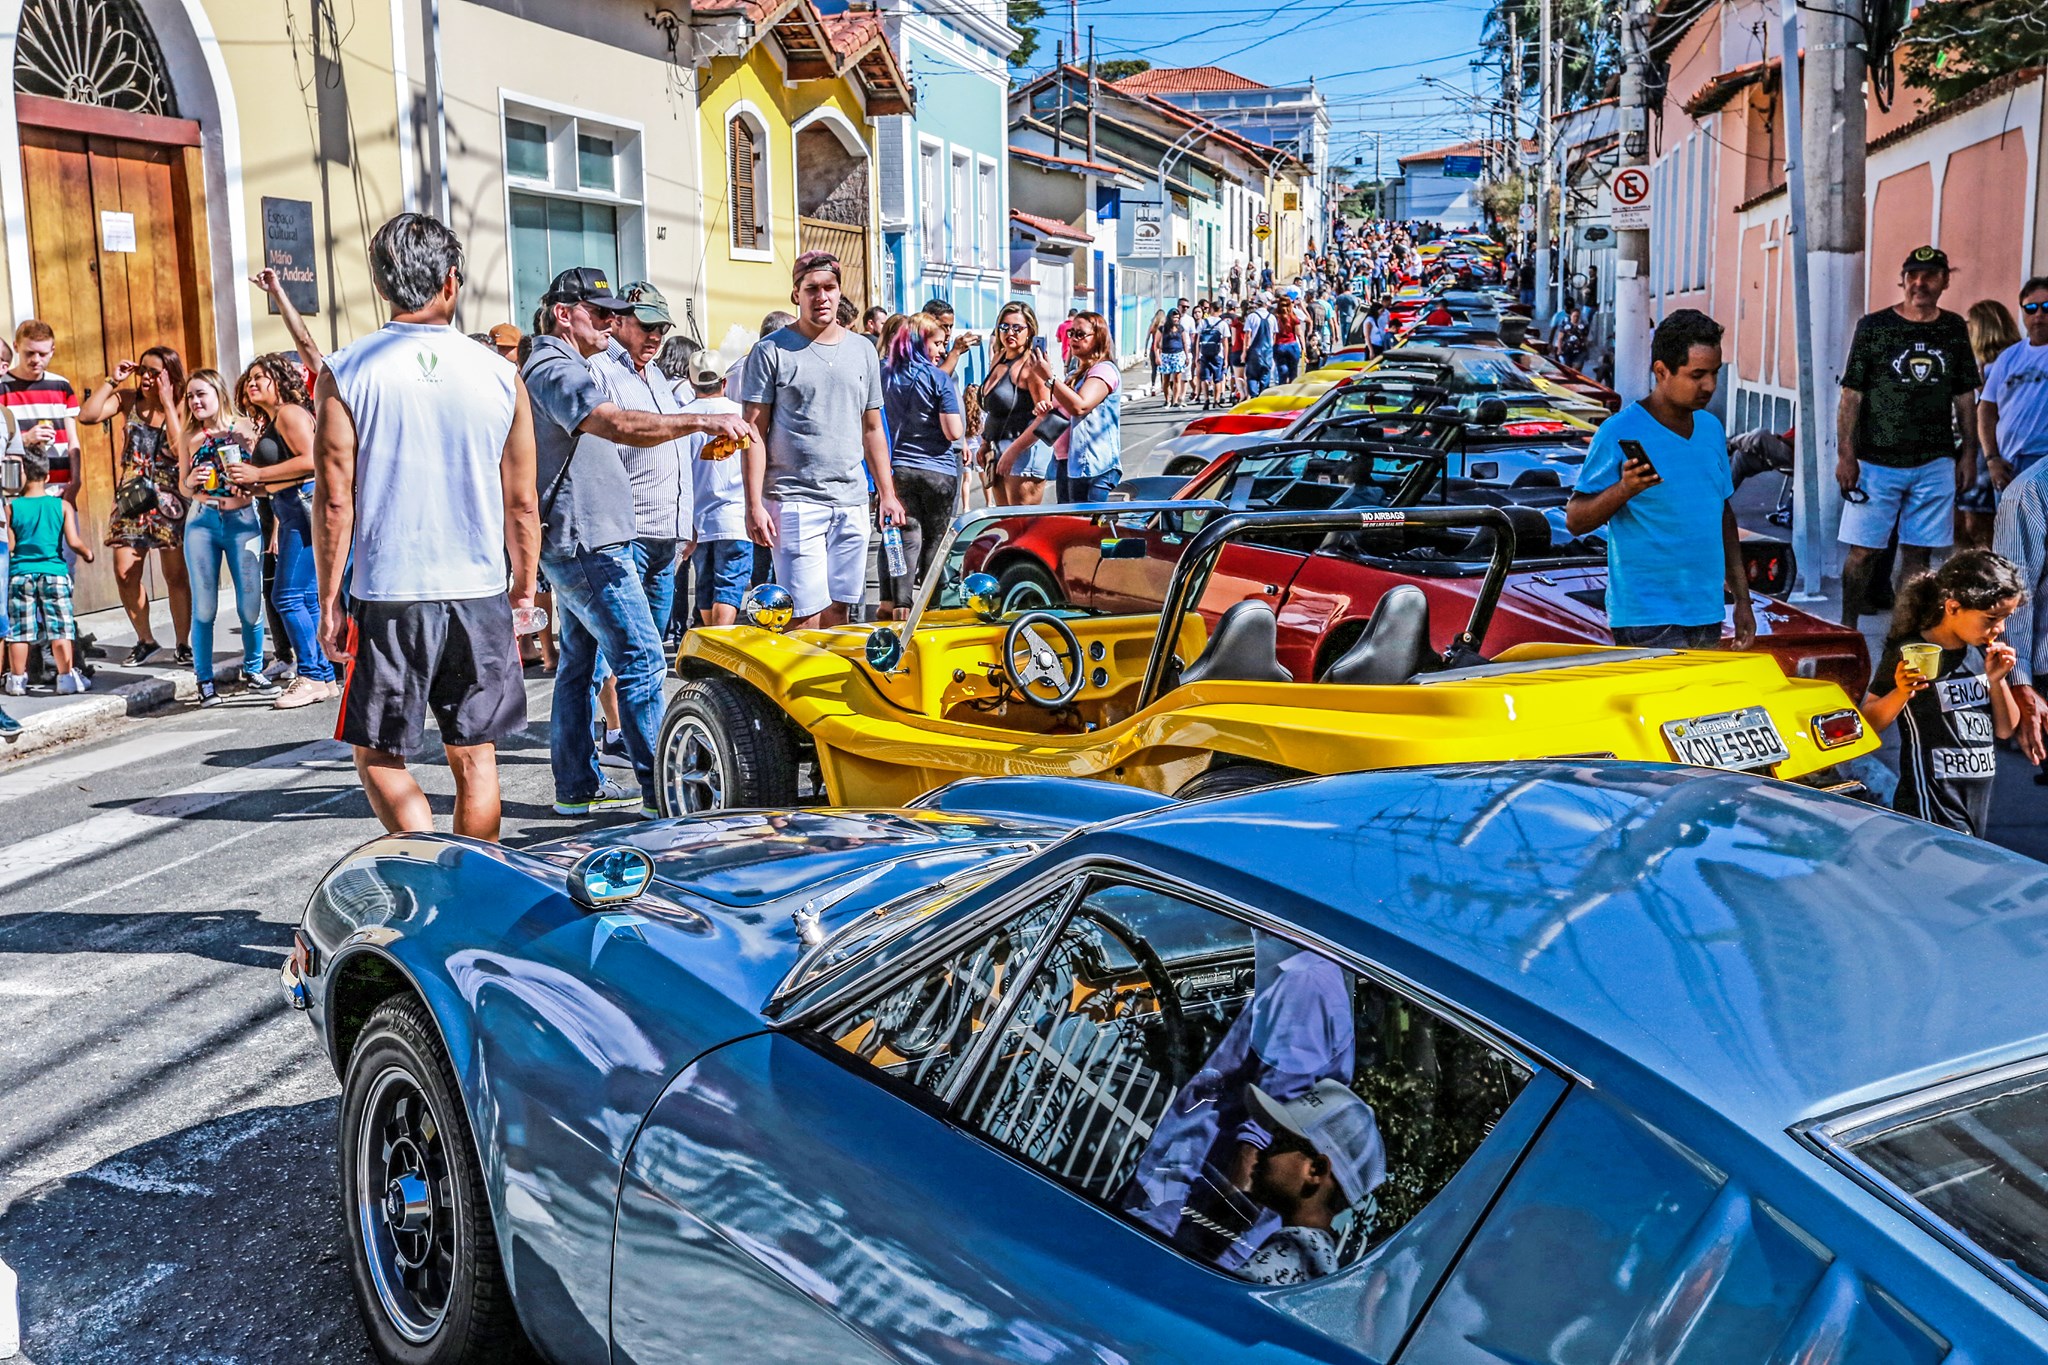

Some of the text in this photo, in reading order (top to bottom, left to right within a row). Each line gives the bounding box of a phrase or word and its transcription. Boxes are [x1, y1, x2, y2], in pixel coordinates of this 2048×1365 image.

[267, 209, 294, 228] Espaço
[268, 225, 298, 241] Cultural
[270, 249, 292, 265] Mário
[282, 266, 314, 282] Andrade
[1362, 511, 1405, 521] NO AIRBAGS
[1948, 680, 1989, 705] ENJOY
[386, 1018, 415, 1042] AUTO
